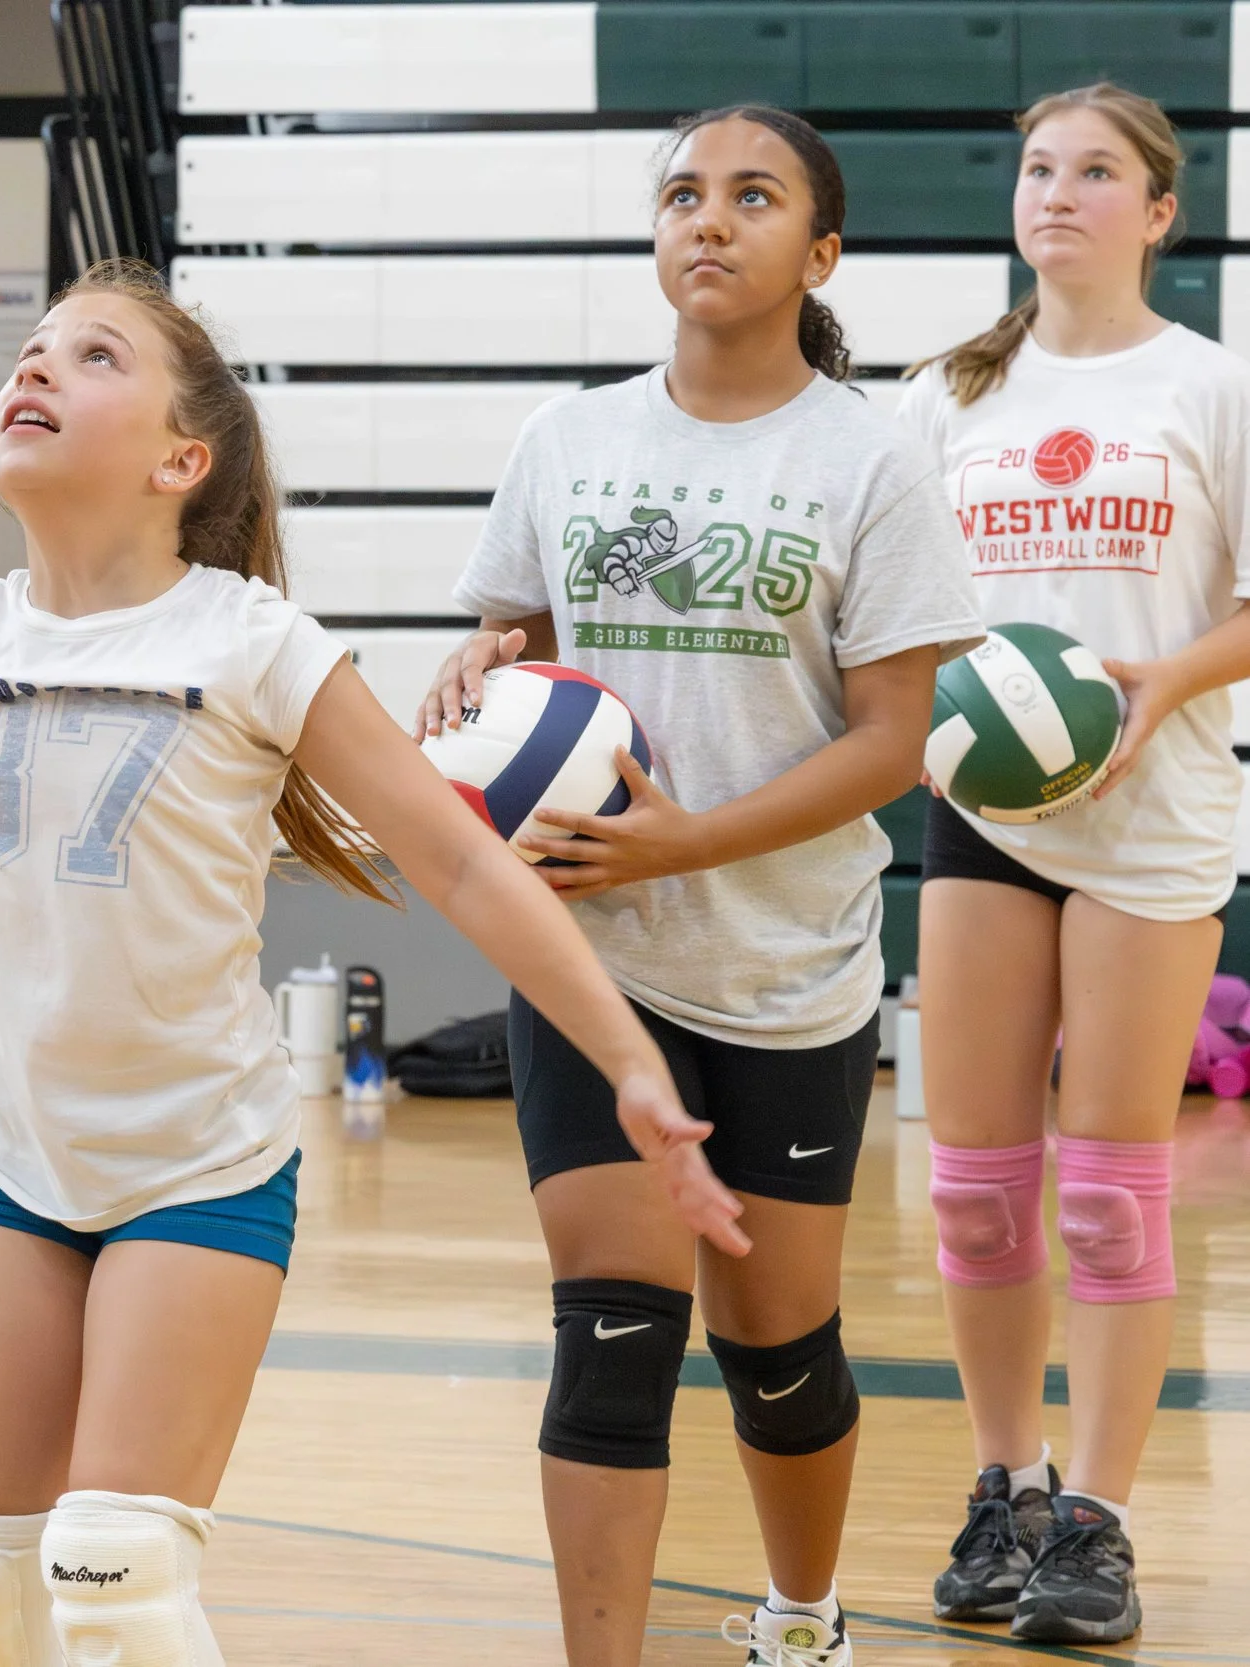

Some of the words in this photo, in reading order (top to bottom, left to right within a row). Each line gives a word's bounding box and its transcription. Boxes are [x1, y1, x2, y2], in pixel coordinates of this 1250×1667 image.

[997, 448, 1027, 468] 20
[1103, 443, 1130, 462] 26
[571, 479, 725, 503] CLASS
[770, 494, 824, 519] OF
[955, 496, 1175, 542] WESTWOOD
[977, 540, 1088, 564] VOLLEYBALL
[1095, 537, 1146, 560] CAMP
[666, 630, 788, 654] ELEMENTAR
